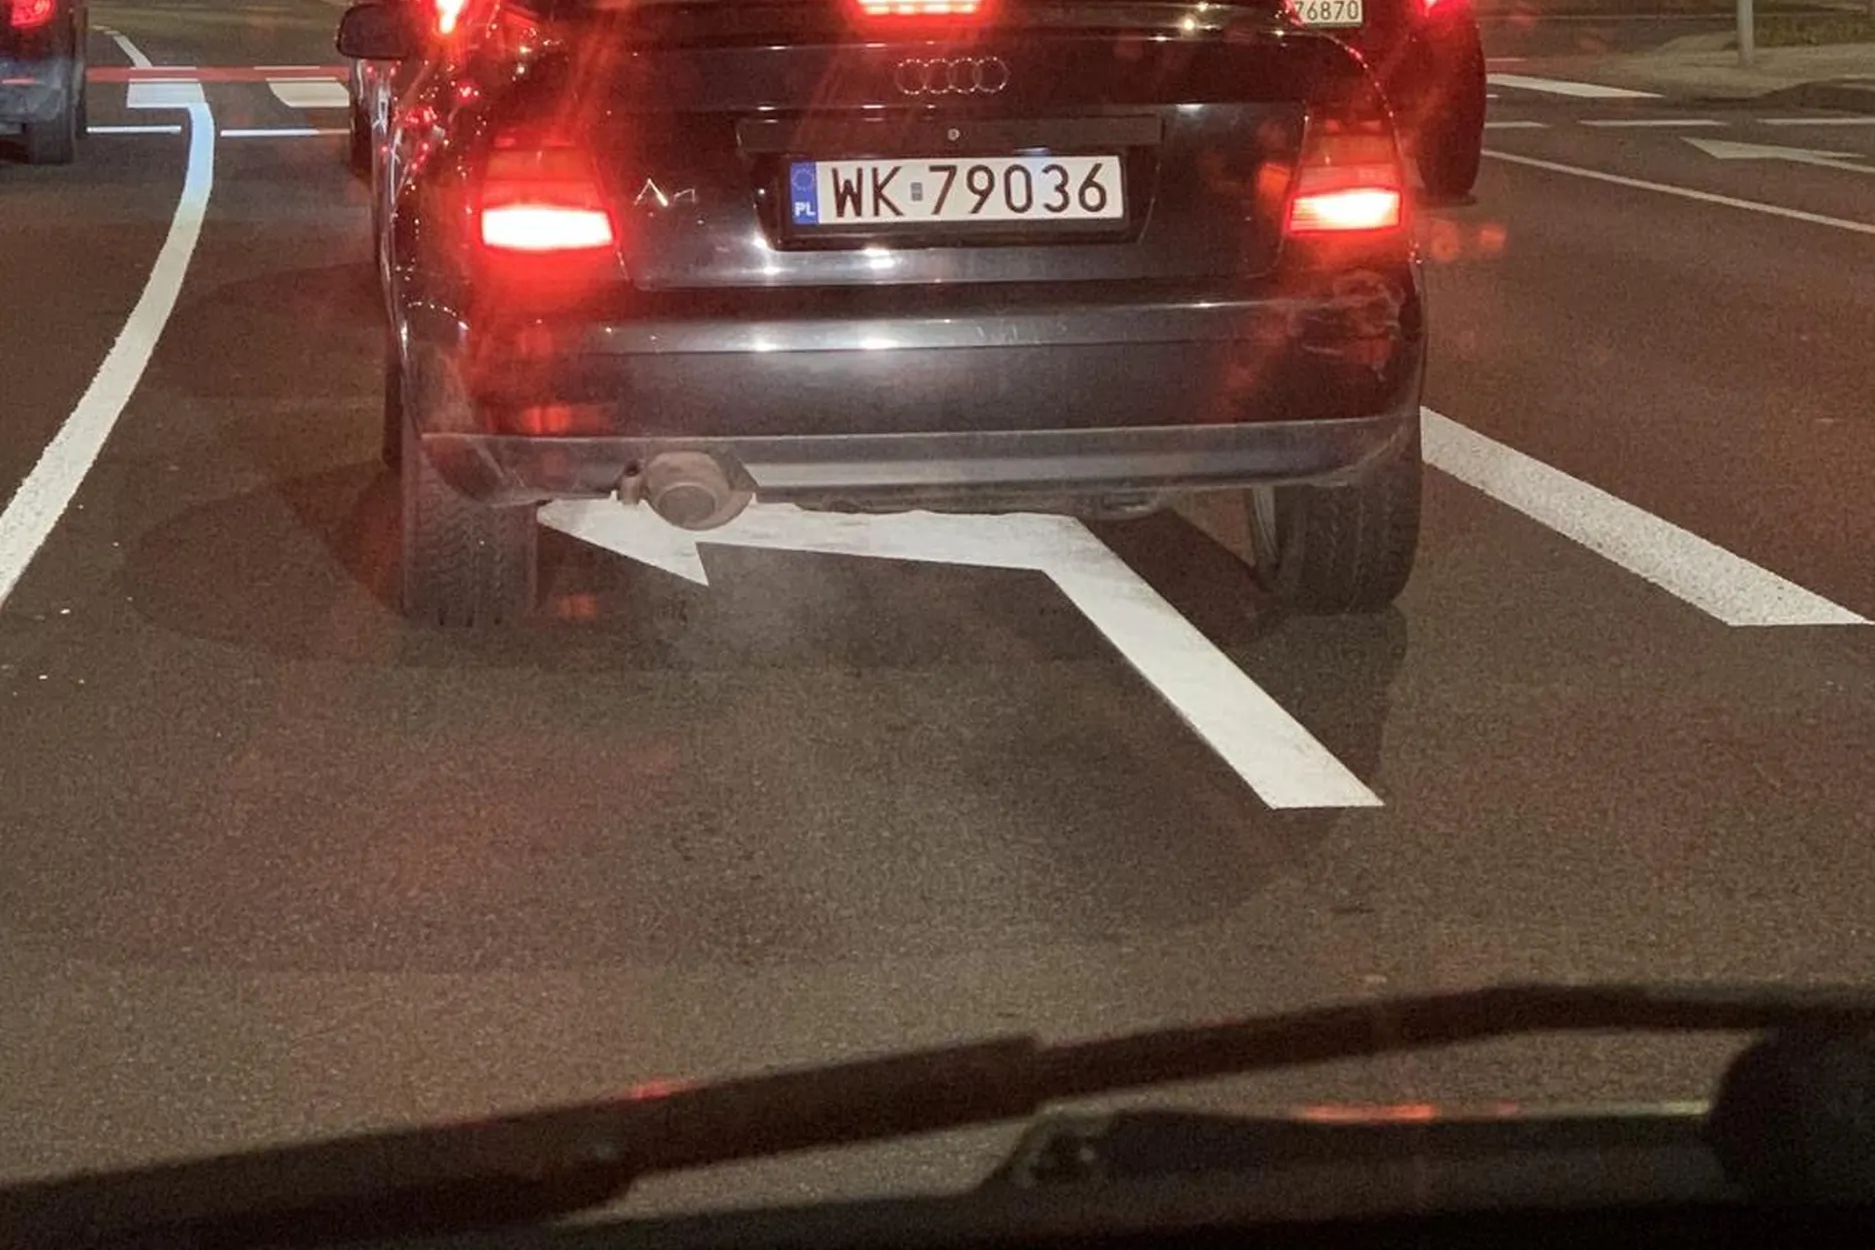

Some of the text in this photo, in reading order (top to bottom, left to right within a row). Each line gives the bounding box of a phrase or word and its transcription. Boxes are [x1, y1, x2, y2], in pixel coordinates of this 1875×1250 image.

[832, 163, 1108, 218] WK 79036
[794, 201, 816, 216] PL
